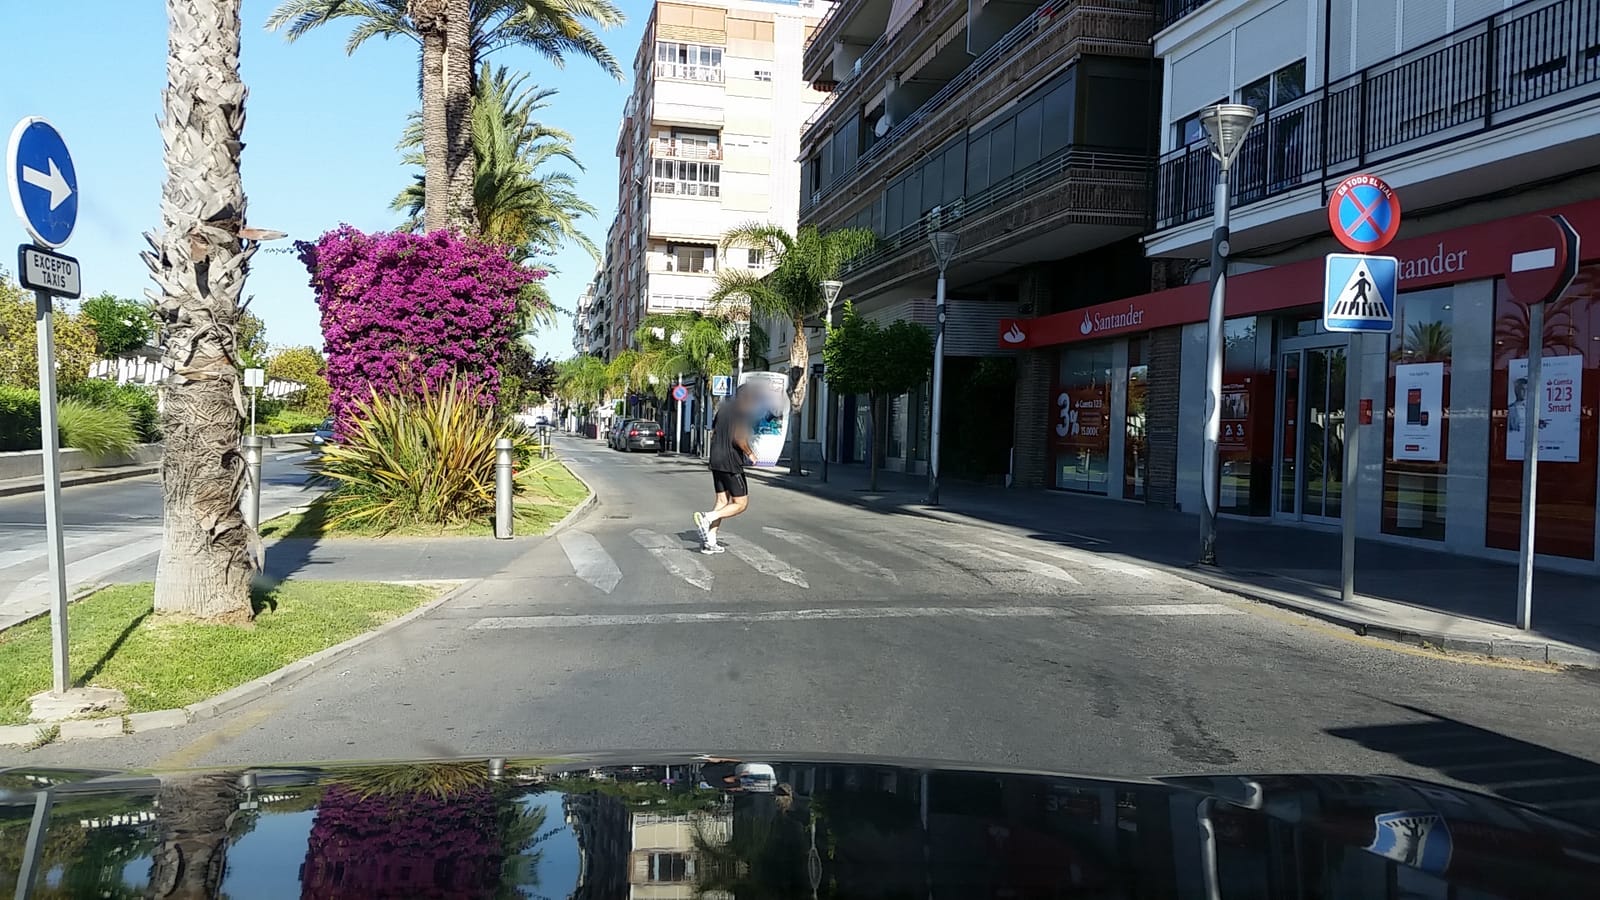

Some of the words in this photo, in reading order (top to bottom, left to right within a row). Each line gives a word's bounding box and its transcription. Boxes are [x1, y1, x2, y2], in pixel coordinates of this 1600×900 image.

[1337, 185, 1348, 196] EN
[1346, 176, 1369, 187] TODO
[1369, 177, 1378, 187] EL
[1379, 182, 1392, 200] VIAL
[34, 254, 72, 276] EXCEPTO
[1398, 241, 1468, 280] tander
[42, 270, 66, 288] TAXIS
[1093, 303, 1144, 332] Santander
[1547, 402, 1572, 413] Smart
